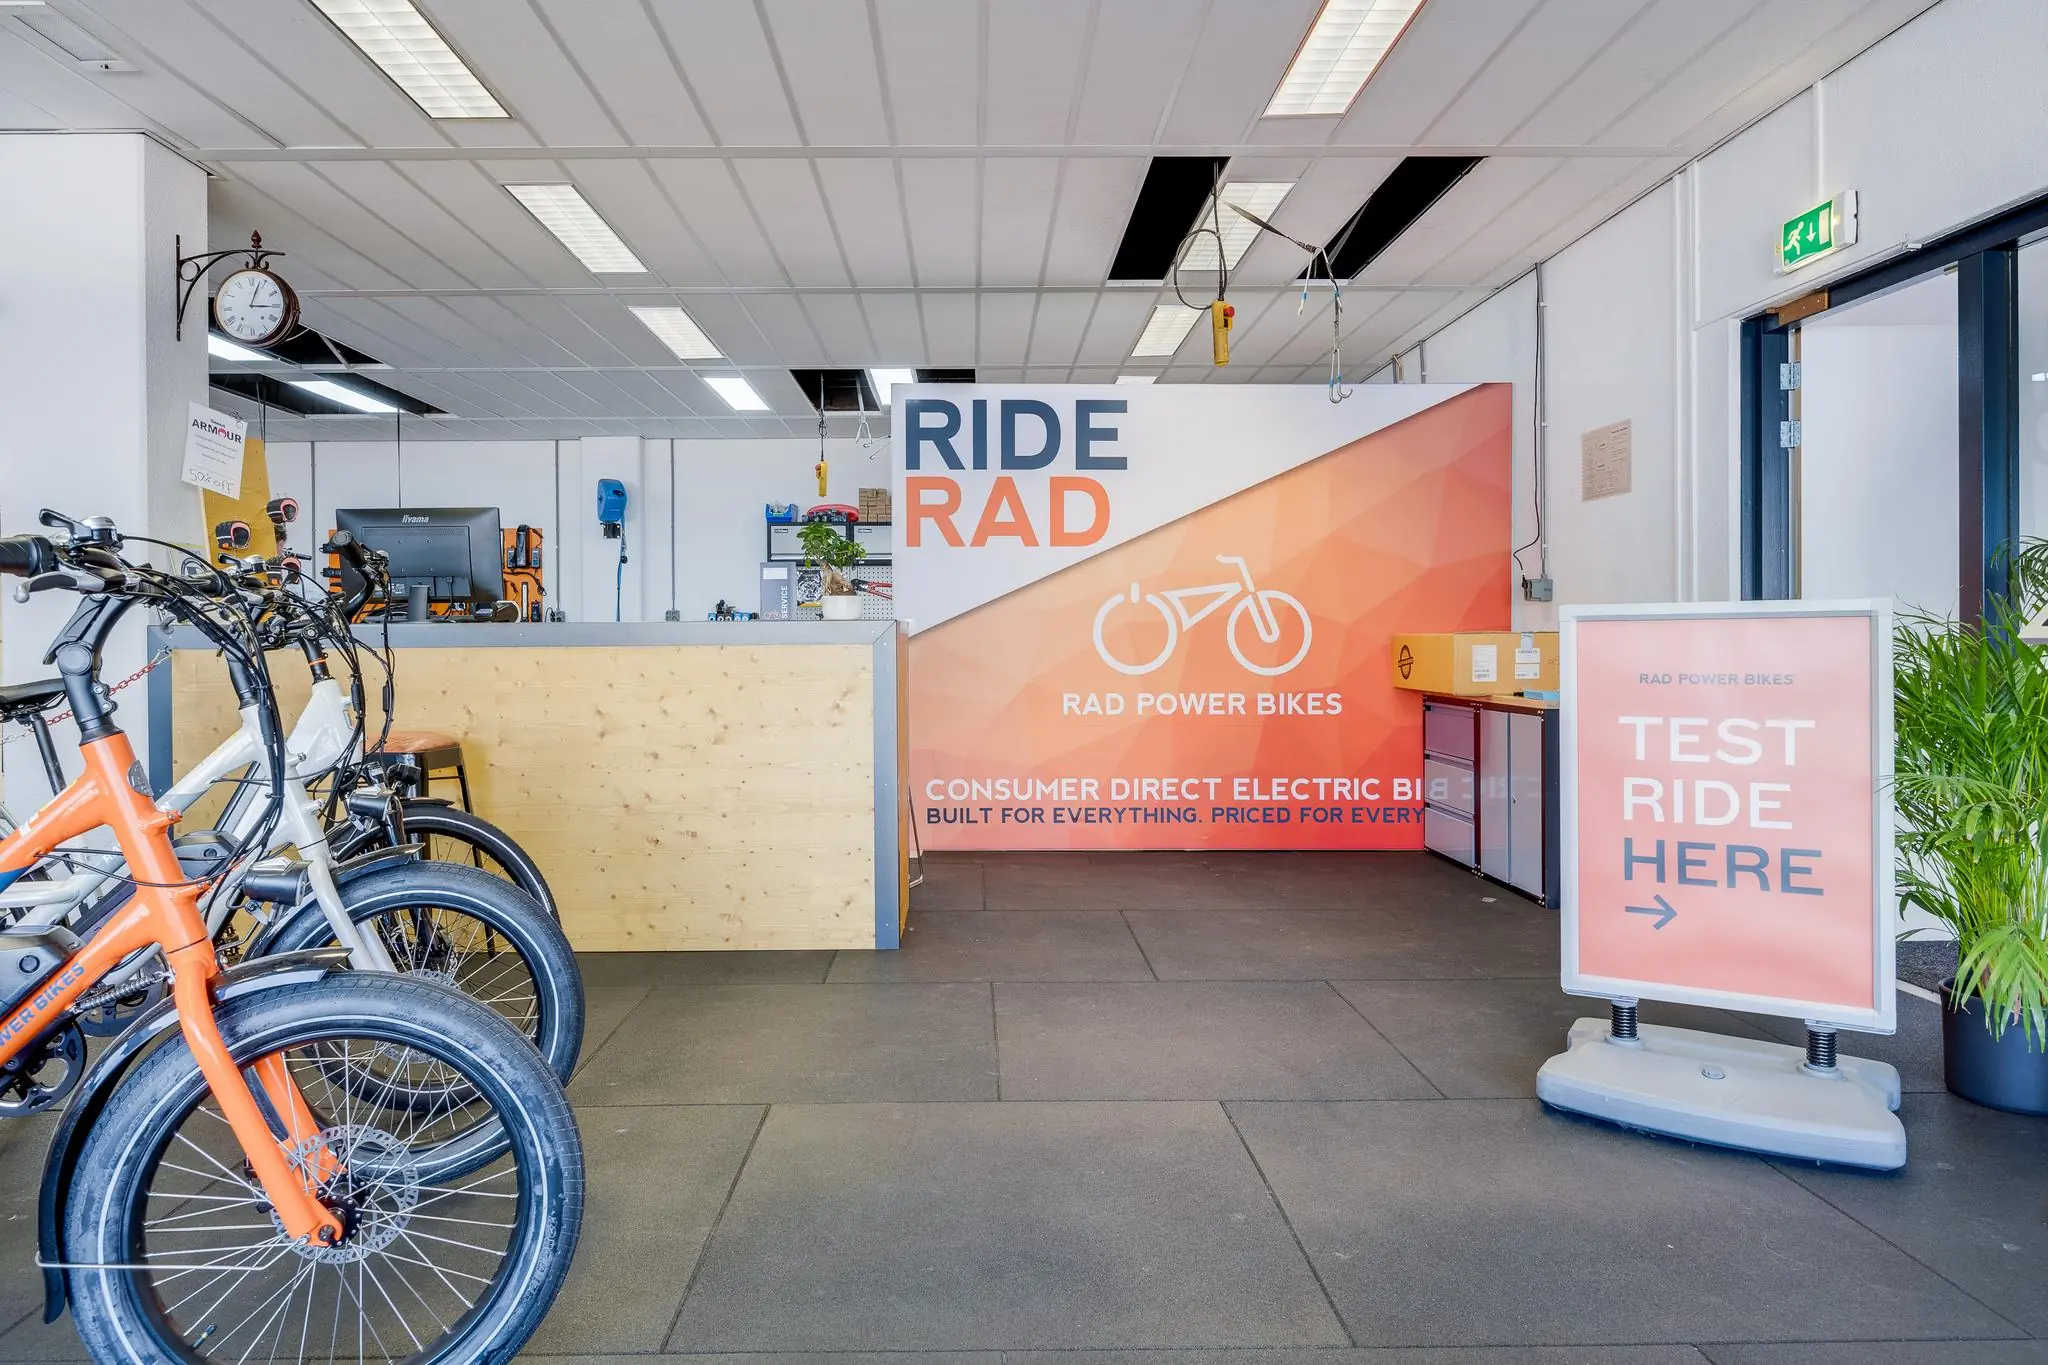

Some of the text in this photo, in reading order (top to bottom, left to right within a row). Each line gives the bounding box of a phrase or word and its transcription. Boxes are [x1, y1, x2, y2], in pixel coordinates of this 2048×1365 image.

[191, 418, 242, 444] ARMOUR
[905, 399, 1128, 470] RIDE
[402, 514, 430, 523] iiyama
[905, 476, 1111, 547] RAD
[1639, 673, 1794, 686] RAD POWER BIKES
[1062, 692, 1343, 716] RAD POWER BIKES
[1618, 716, 1816, 766] TEST
[926, 777, 1100, 801] CONSUMER
[1111, 777, 1222, 801] DIRECT
[1233, 777, 1380, 801] ELECTRIC
[1623, 777, 1793, 830] RIDE
[926, 807, 1425, 824] BUILT FOR EVERYTHING. PRICED FOR EVERY
[1623, 837, 1825, 896] HERE
[33, 962, 85, 1012] BIKES
